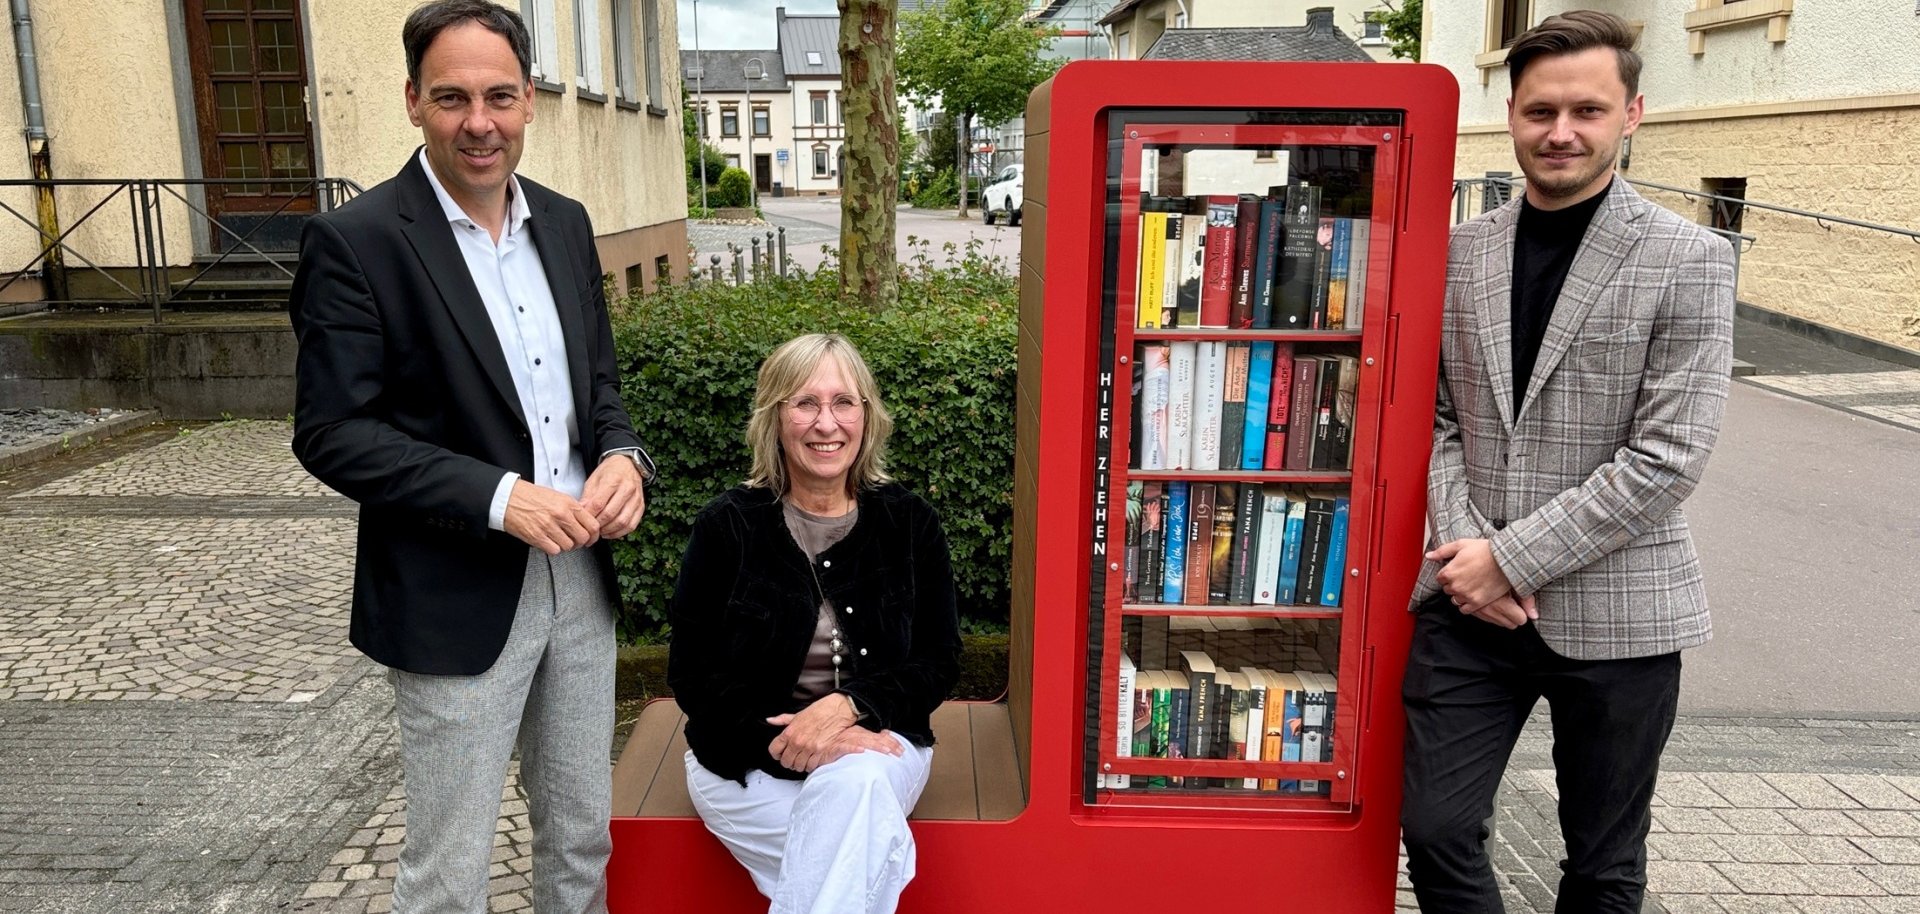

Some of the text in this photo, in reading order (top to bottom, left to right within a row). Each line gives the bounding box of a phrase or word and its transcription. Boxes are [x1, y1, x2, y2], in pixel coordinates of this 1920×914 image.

[1208, 230, 1222, 285] Kate Morton
[1238, 222, 1254, 305] Ann Cleeves Sturmwarnung
[1263, 280, 1271, 296] Cleeves
[1240, 352, 1248, 374] Mutter
[1233, 366, 1241, 386] Asche
[1180, 392, 1190, 437] SLAUGHTER
[1276, 406, 1285, 419] TOTE
[1201, 427, 1209, 451] KARIN
[1207, 416, 1217, 461] SLAUGHTER
[1094, 372, 1111, 555] HIER ZIEHEN
[1197, 503, 1212, 519] 19
